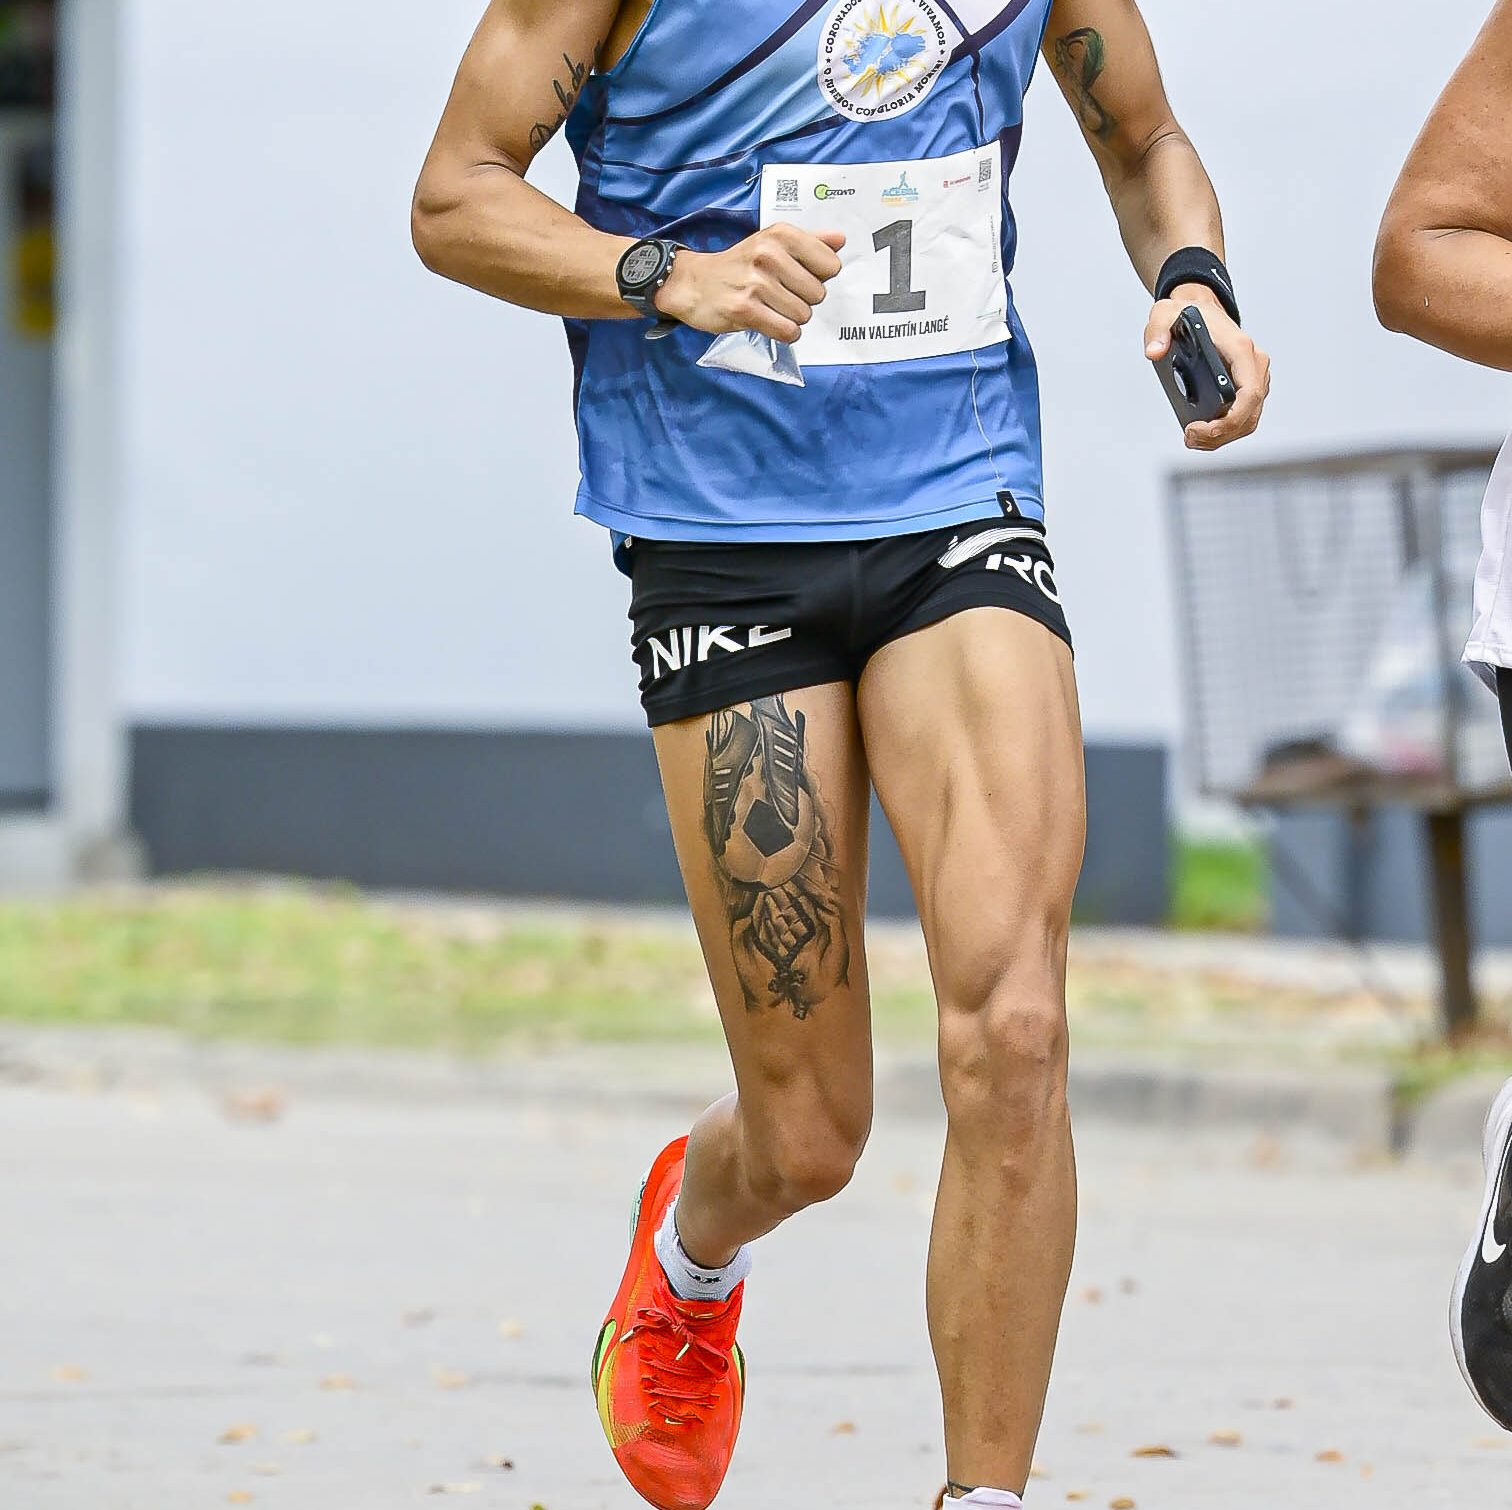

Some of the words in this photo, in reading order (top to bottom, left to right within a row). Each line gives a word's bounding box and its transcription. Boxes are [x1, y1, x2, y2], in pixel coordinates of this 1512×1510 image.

[918, 0, 946, 46] VIVAMOS
[823, 67, 832, 76] O
[877, 92, 915, 114] GLORIA
[872, 219, 927, 314] 1
[838, 326, 866, 341] JUAN
[868, 320, 917, 340] VALENTÍN
[919, 314, 950, 335] LANGÉ
